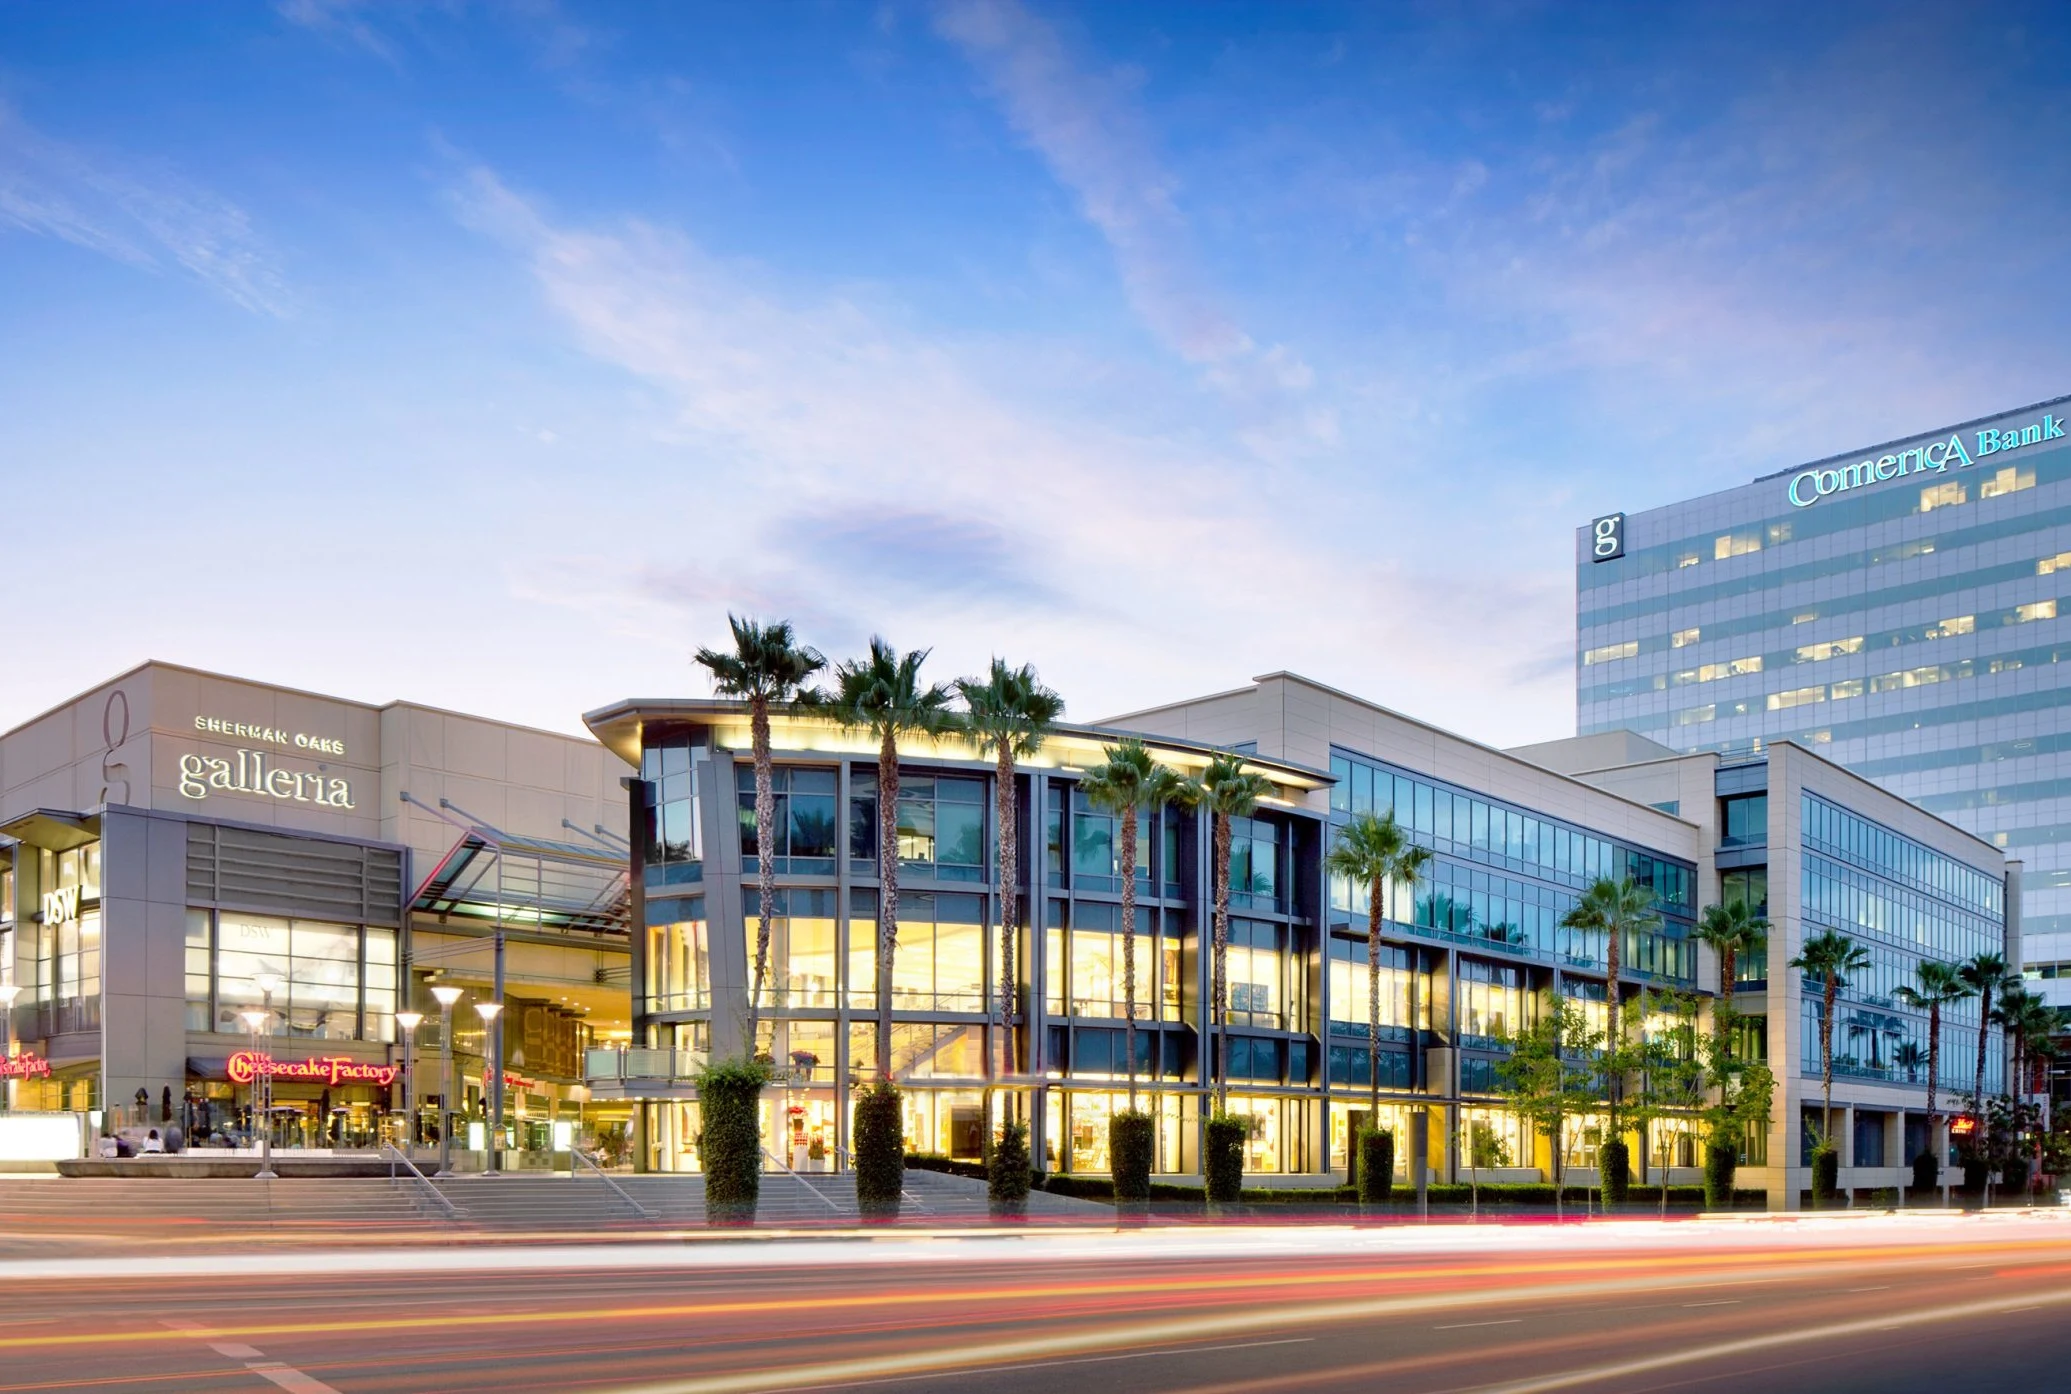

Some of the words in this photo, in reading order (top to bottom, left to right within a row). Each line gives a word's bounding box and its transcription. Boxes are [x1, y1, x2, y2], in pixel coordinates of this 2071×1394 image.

[1976, 414, 2066, 458] Bank
[1594, 516, 1621, 556] g
[194, 715, 288, 745] SHERMAN
[294, 732, 346, 756] OAKS
[179, 749, 356, 810] galleria
[43, 884, 81, 927] DSW
[240, 923, 270, 939] DSW
[227, 1051, 331, 1084] Cheesecake
[321, 1056, 400, 1086] Factory
